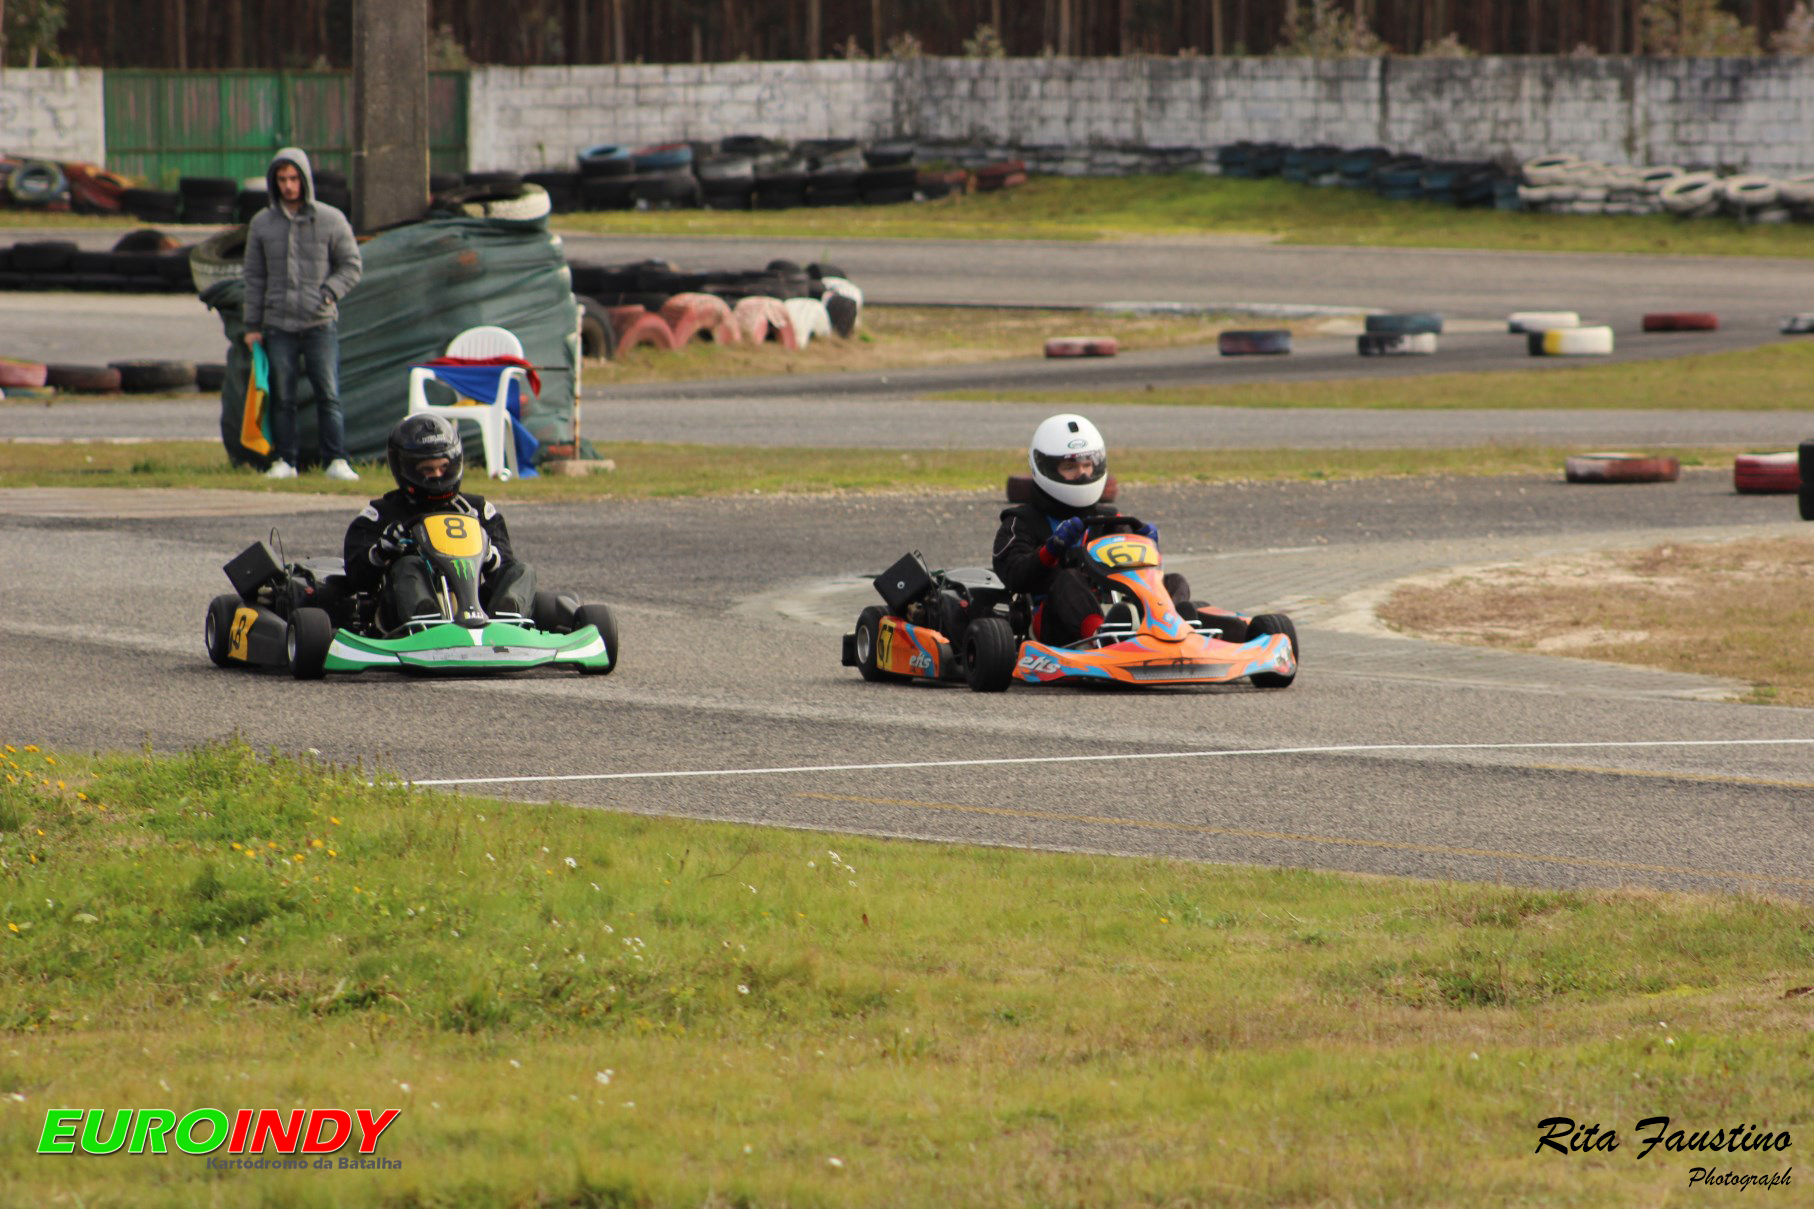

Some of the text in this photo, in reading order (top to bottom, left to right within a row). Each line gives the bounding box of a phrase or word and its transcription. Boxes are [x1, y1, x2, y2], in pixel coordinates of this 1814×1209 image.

[443, 517, 468, 539] 8
[1106, 544, 1147, 565] 67
[233, 614, 247, 650] 8
[879, 623, 894, 663] 67
